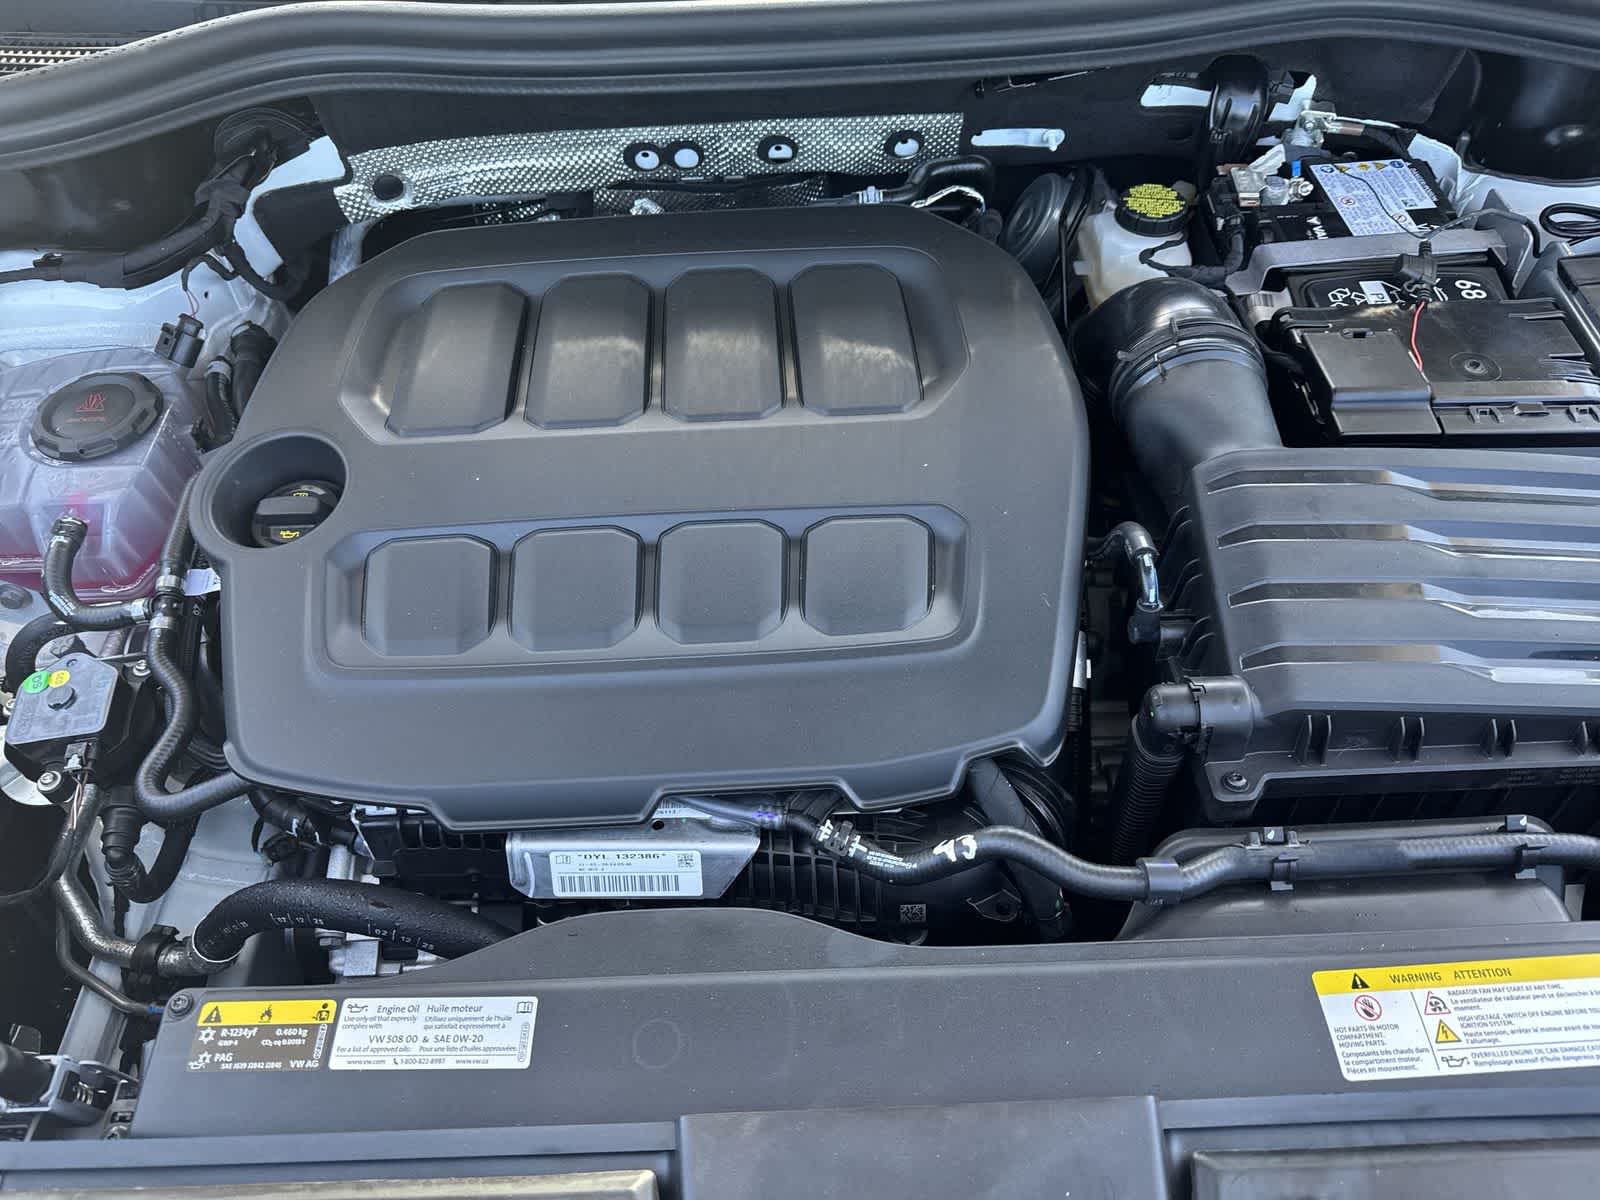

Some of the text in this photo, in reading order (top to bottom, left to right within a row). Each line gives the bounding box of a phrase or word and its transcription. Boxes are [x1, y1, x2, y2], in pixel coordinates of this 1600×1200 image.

[1454, 280, 1487, 299] 68
[1389, 967, 1512, 984] WARNING ATTENTION
[1447, 988, 1478, 996] RADIATOR
[1460, 995, 1493, 1003] ventilateur
[1494, 994, 1501, 1002] de
[1503, 993, 1531, 1001] radiateur
[376, 1003, 483, 1015] Engine Oil Huile moteur
[1503, 1011, 1527, 1019] SWITCH
[1540, 1009, 1563, 1017] ENGINE
[1564, 1007, 1588, 1015] BEFORE
[355, 1015, 367, 1023] only
[391, 1015, 417, 1024] expressly
[425, 1015, 447, 1023] Utilisez
[448, 1015, 485, 1023] uniquement
[342, 1023, 367, 1031] complies
[423, 1023, 433, 1031] qui
[434, 1022, 458, 1030] satisfait
[1334, 1025, 1348, 1033] HOT
[1349, 1024, 1368, 1032] PARTS
[1376, 1023, 1399, 1031] MOTOR
[1463, 1029, 1483, 1037] Haute
[1564, 1024, 1581, 1032] avant
[220, 1027, 258, 1039] R-1234yf
[298, 1027, 309, 1038] kg
[369, 1034, 484, 1043] VW 508 00 & SAE 0W-20
[369, 1045, 398, 1054] approved
[419, 1045, 433, 1053] Pour
[446, 1045, 458, 1053] liste
[459, 1045, 481, 1053] d'huiles
[1342, 1049, 1379, 1058] Composants
[1393, 1047, 1414, 1055] chauds
[1471, 1050, 1509, 1058] OVERFILLED
[1510, 1047, 1533, 1056] ENGINE
[1534, 1047, 1545, 1055] OIL
[1545, 1046, 1559, 1054] CAN
[1560, 1045, 1586, 1053] DAMAGE
[214, 1053, 233, 1062] PAG
[1351, 1056, 1396, 1066] compartiment
[1473, 1058, 1513, 1067] Remplissage
[1515, 1056, 1539, 1064] excessif
[1562, 1054, 1594, 1063] dangereux
[289, 1060, 305, 1068] VW
[304, 1060, 320, 1068] AG
